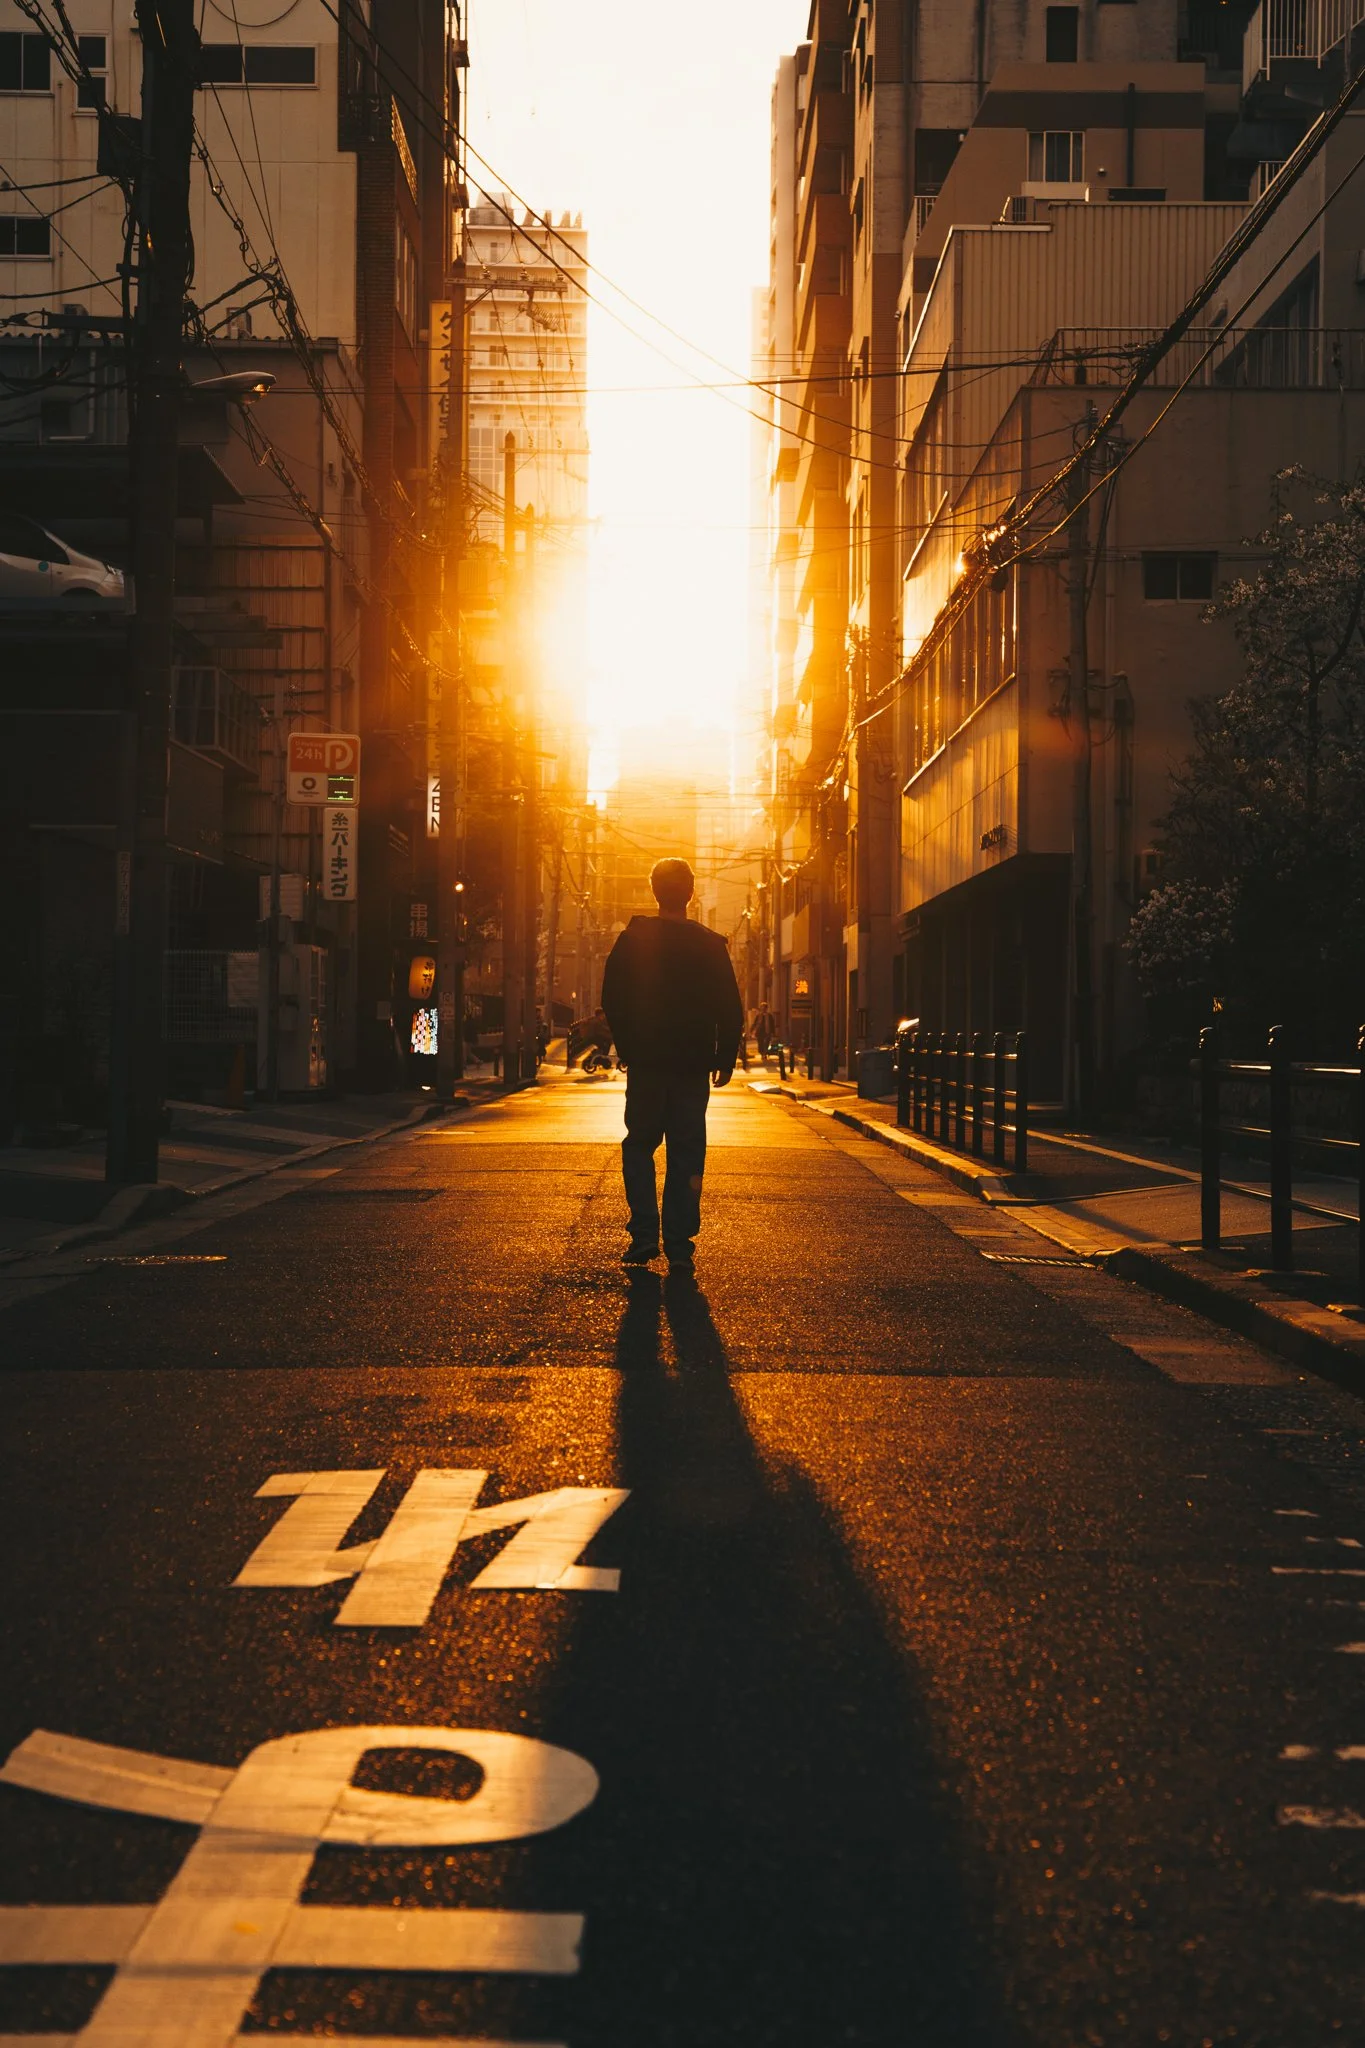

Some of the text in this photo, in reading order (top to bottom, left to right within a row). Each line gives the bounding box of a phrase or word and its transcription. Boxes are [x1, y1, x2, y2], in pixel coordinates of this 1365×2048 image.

[296, 739, 354, 771] 24h P
[331, 811, 350, 898] 糸一パーキング
